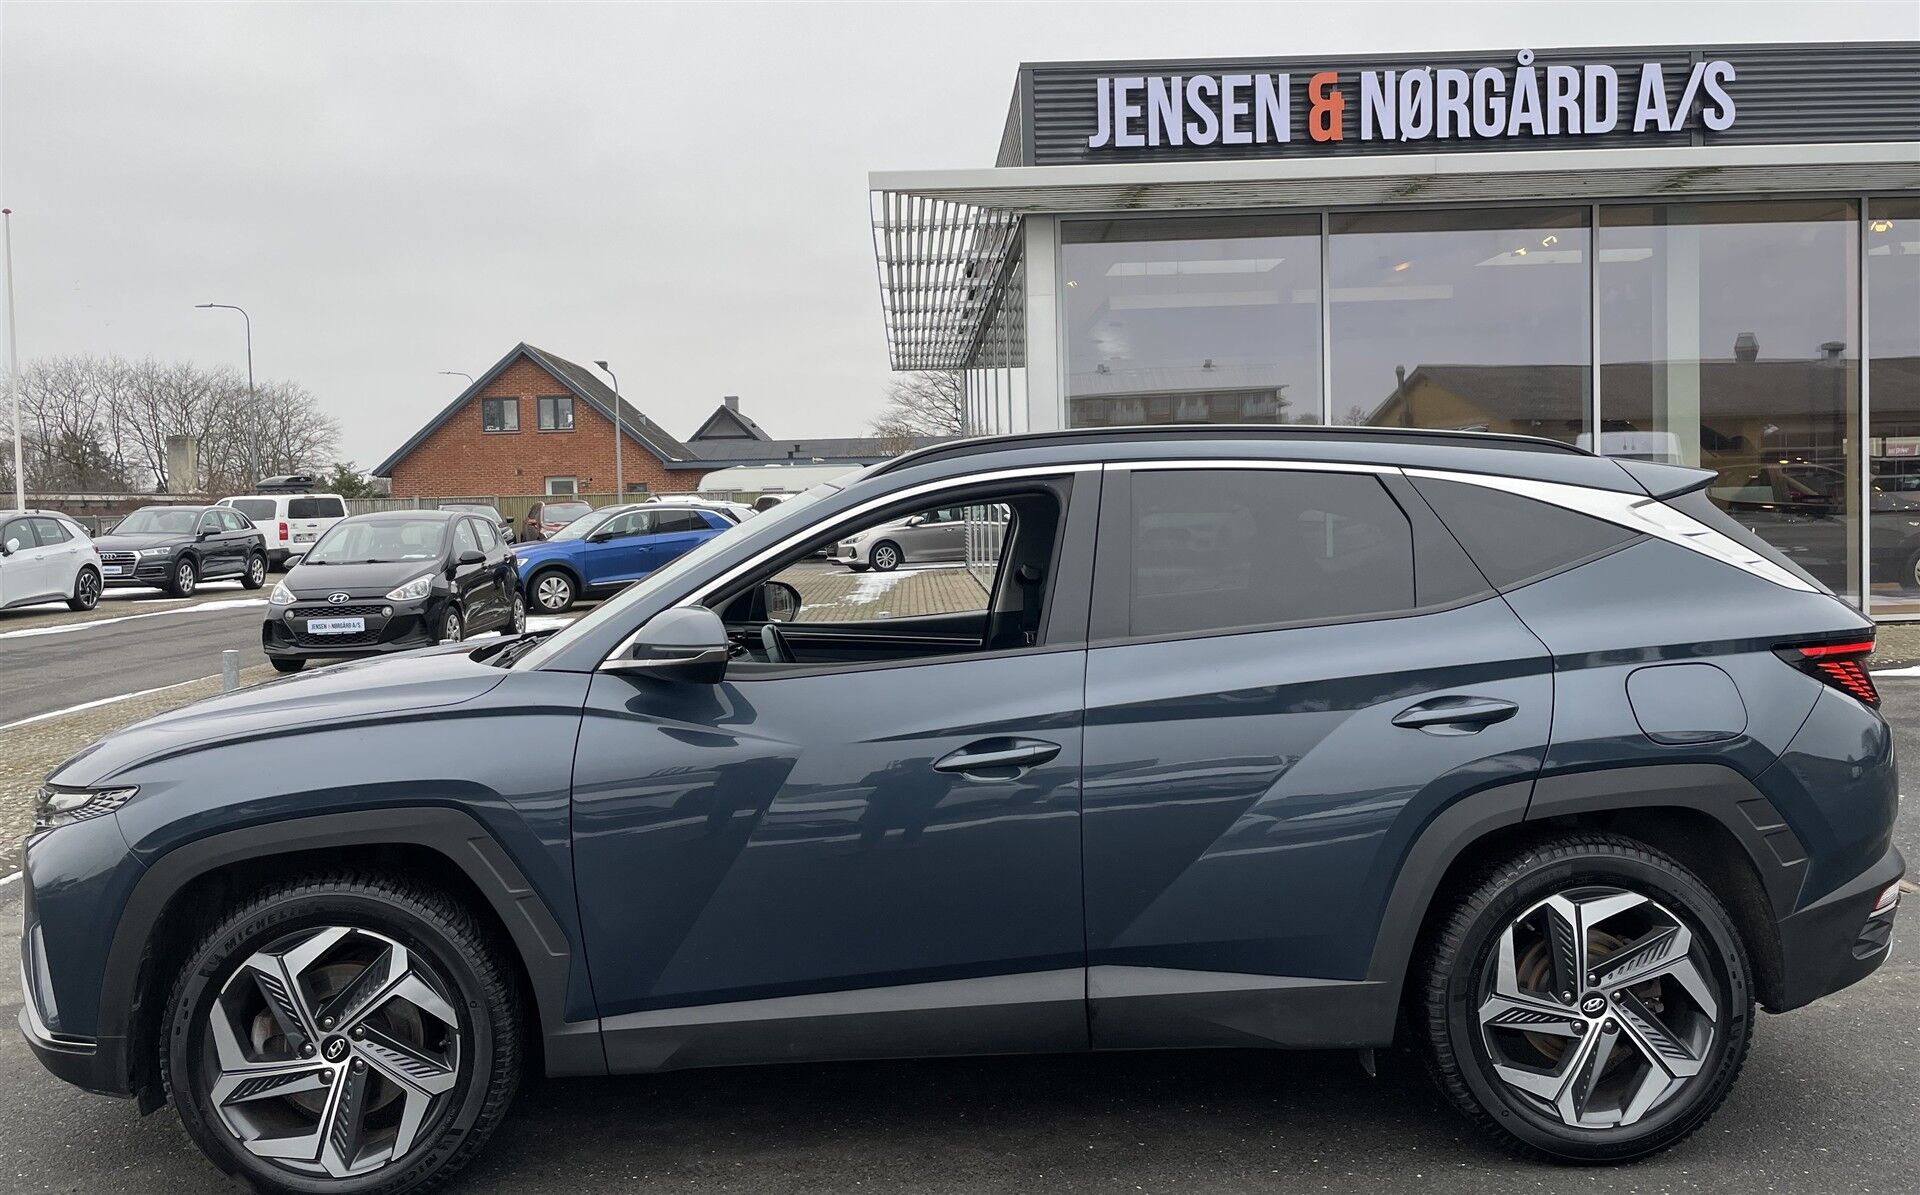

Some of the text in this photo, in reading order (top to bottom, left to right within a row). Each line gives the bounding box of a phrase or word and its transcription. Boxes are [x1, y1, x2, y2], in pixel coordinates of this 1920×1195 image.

[1089, 48, 1736, 148] JENSEN & NØRGÅRD A/S
